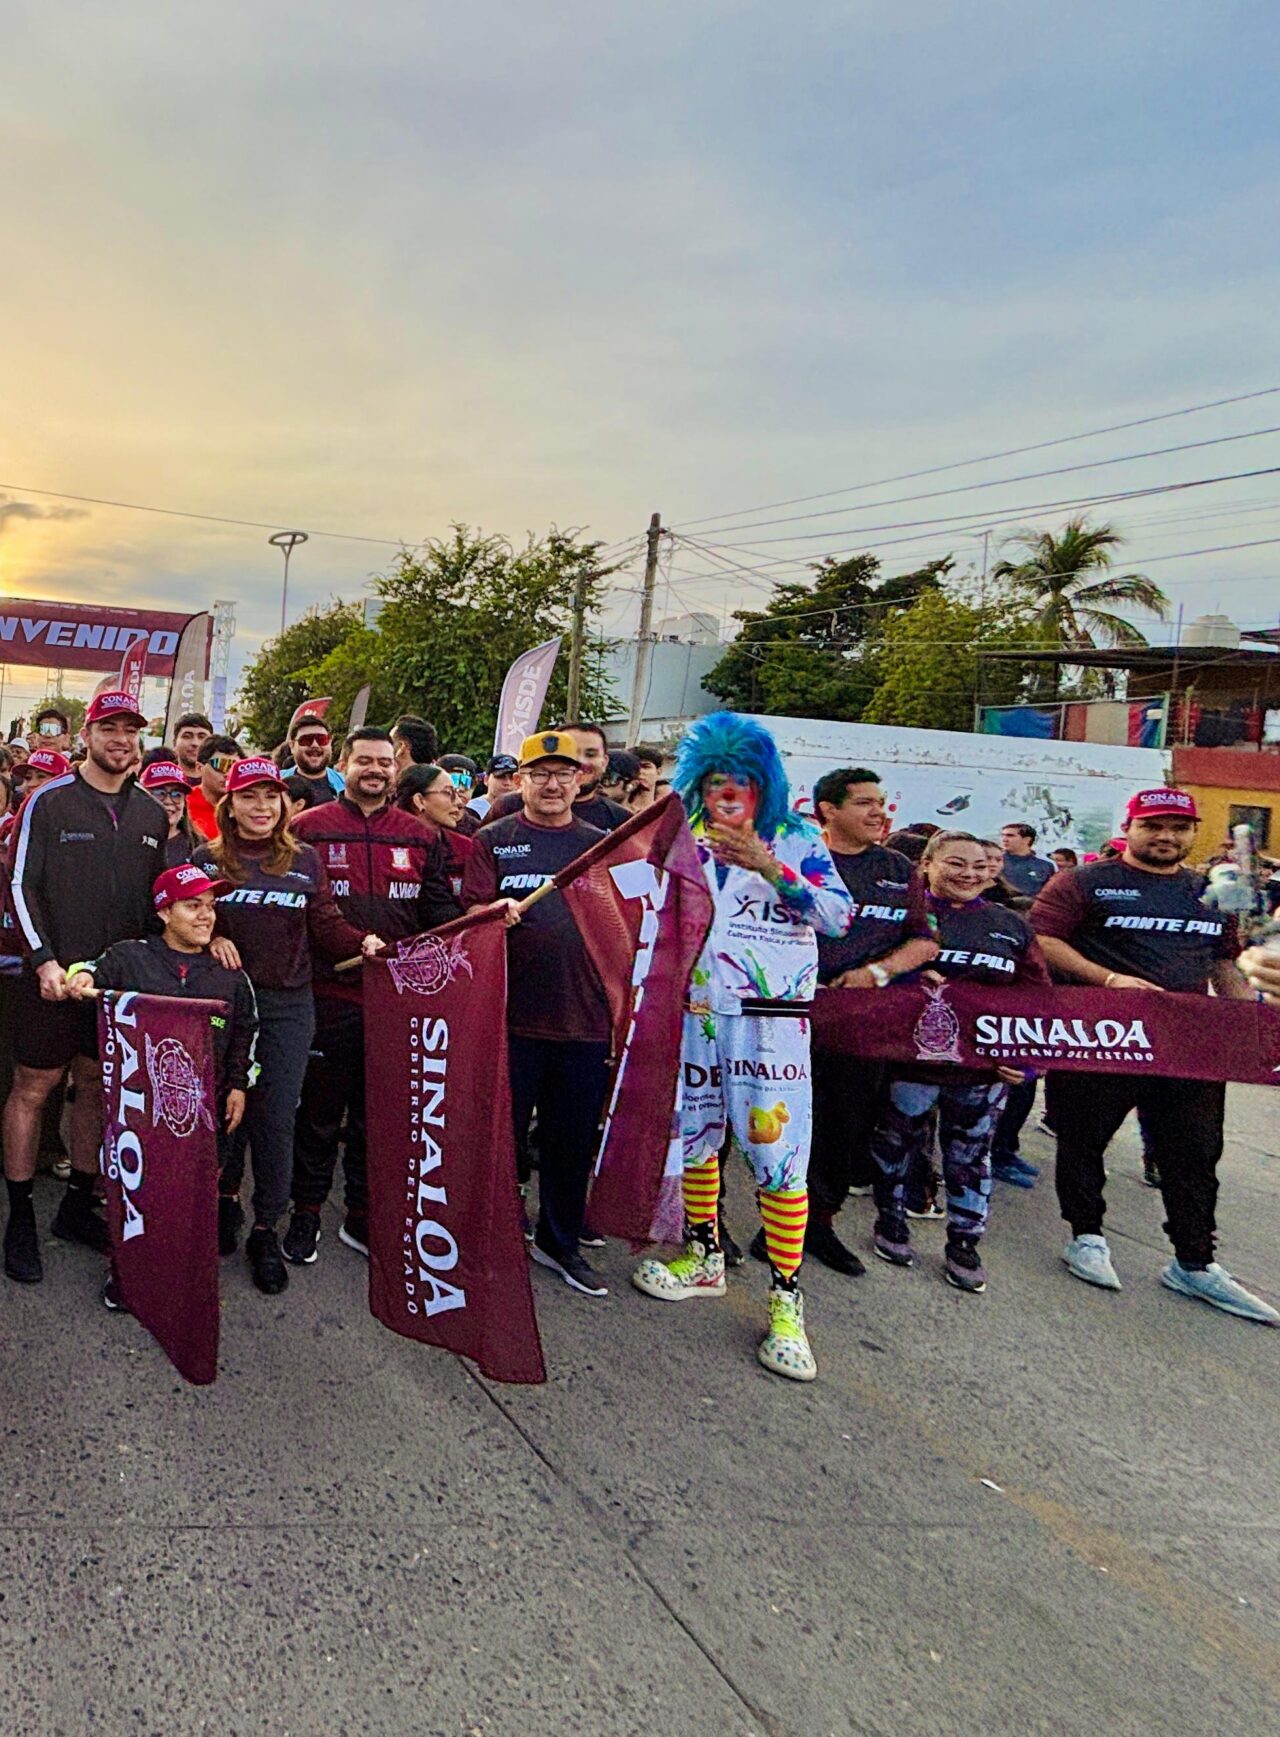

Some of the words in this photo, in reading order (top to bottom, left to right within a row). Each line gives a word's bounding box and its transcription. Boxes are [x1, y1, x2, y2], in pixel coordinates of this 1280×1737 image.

[128, 661, 141, 699] SDE
[1140, 793, 1191, 805] CONADE
[493, 844, 532, 855] CONADE
[263, 891, 307, 909] PILA
[1095, 887, 1141, 897] CONADE
[860, 904, 908, 922] PILA
[1104, 915, 1185, 934] PONTE
[972, 952, 1016, 975] PILA
[975, 1014, 1152, 1049] SINALOA
[975, 1046, 1062, 1059] GOBIERNO
[1066, 1050, 1090, 1060] DEL
[1095, 1051, 1155, 1062] ESTADO
[409, 1016, 419, 1143] GOBIERNO
[725, 1059, 809, 1081] SINALOA
[415, 1017, 467, 1318] SINALOA
[407, 1158, 416, 1201] DEL
[403, 1217, 419, 1315] ESTADO
